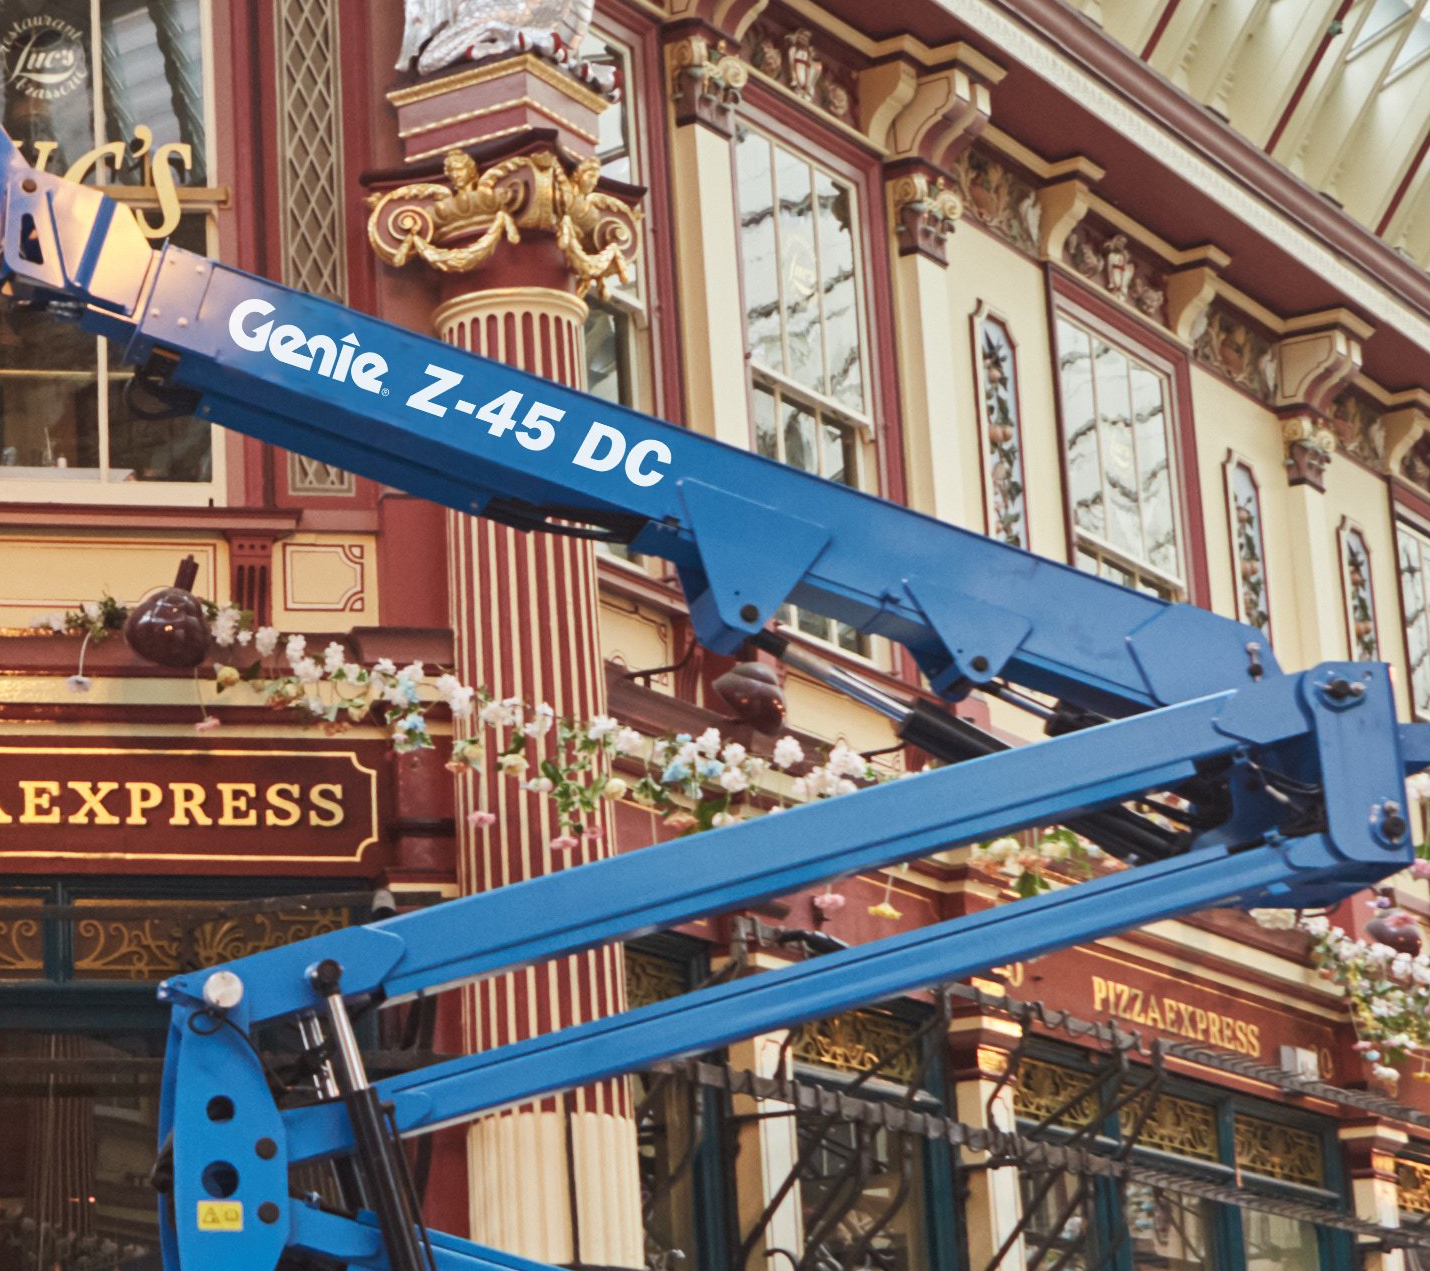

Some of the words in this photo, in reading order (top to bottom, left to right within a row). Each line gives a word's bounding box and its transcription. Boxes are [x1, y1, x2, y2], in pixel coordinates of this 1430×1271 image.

[228, 298, 389, 396] Genie
[405, 364, 566, 451] Z-45
[572, 421, 672, 488] DC
[1092, 976, 1260, 1059] PIZZAEXPRESS
